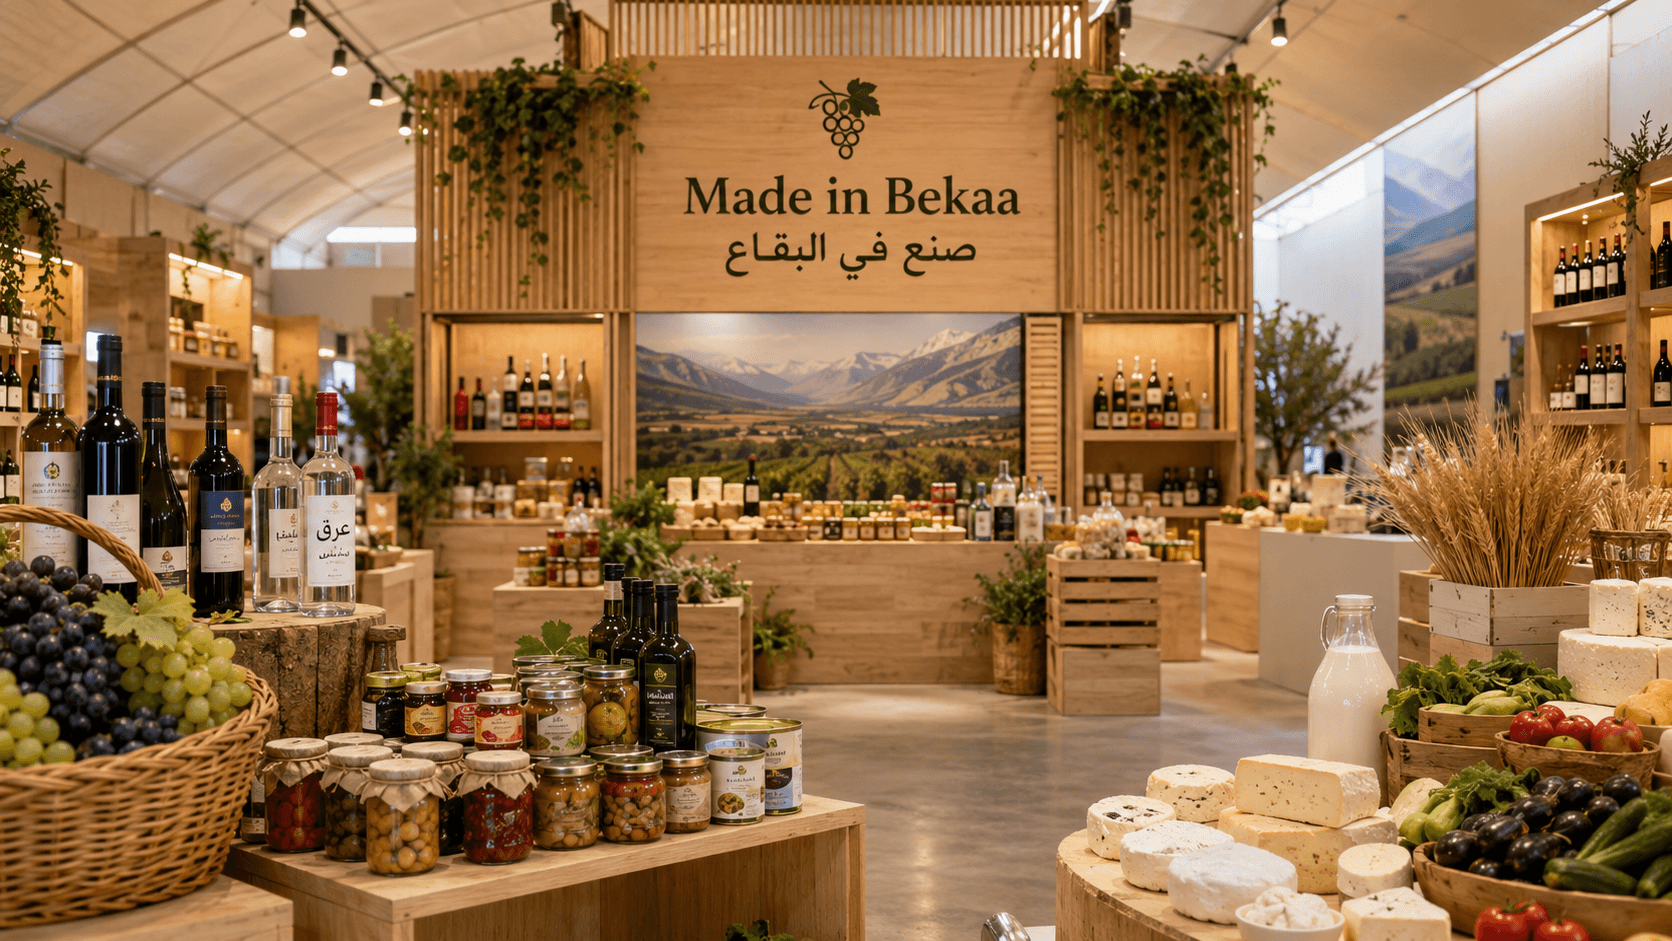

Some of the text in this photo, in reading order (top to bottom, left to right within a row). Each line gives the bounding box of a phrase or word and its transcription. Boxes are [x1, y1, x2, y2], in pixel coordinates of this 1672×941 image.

[683, 174, 1021, 216] Made in Bekaa
[725, 231, 977, 281] صنع في البقاع
[316, 519, 350, 542] عرق
